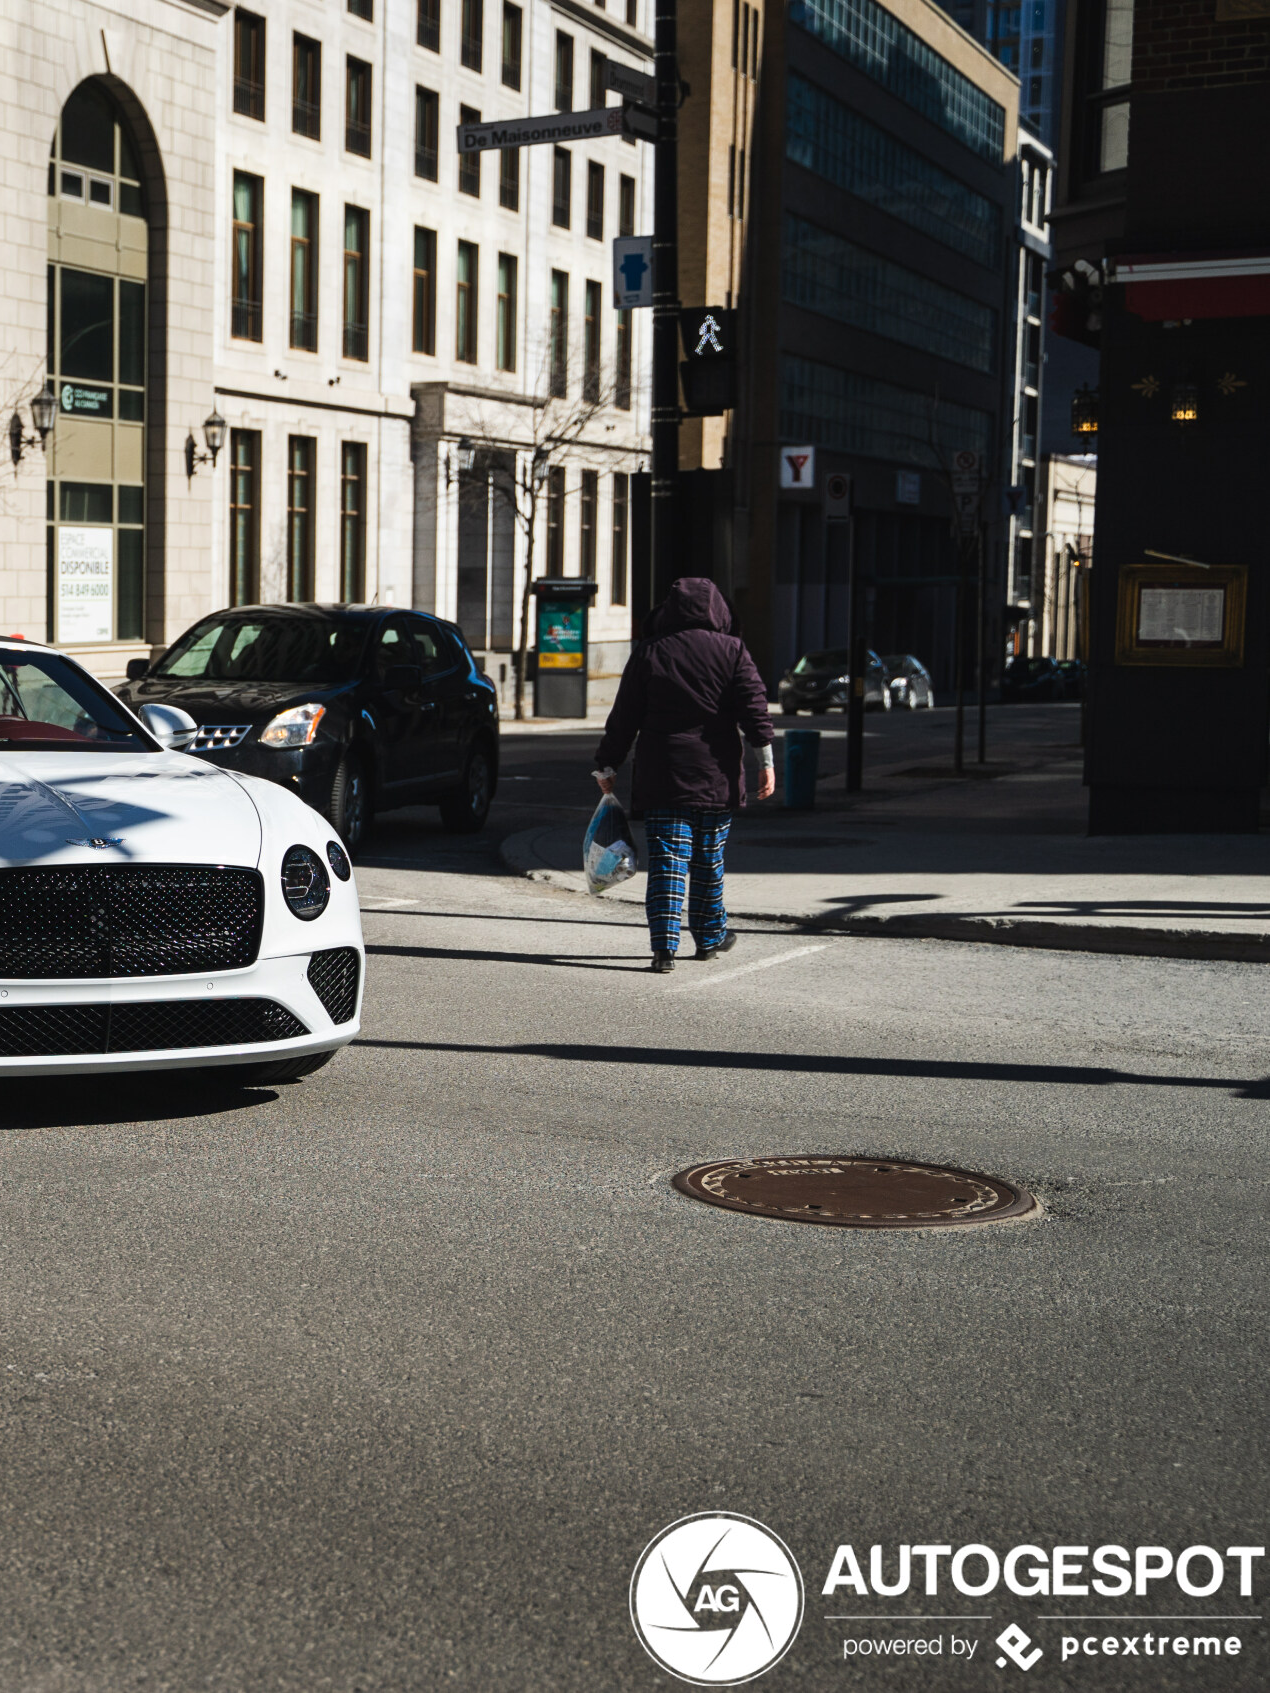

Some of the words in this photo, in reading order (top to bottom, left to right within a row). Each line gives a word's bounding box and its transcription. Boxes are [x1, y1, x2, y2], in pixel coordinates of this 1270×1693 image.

[464, 134, 487, 148] De
[491, 121, 603, 145] Maisonneuve
[61, 561, 109, 575] DISPONIBLE
[61, 583, 74, 597] 514
[75, 583, 90, 597] 849
[91, 583, 109, 596] 6000
